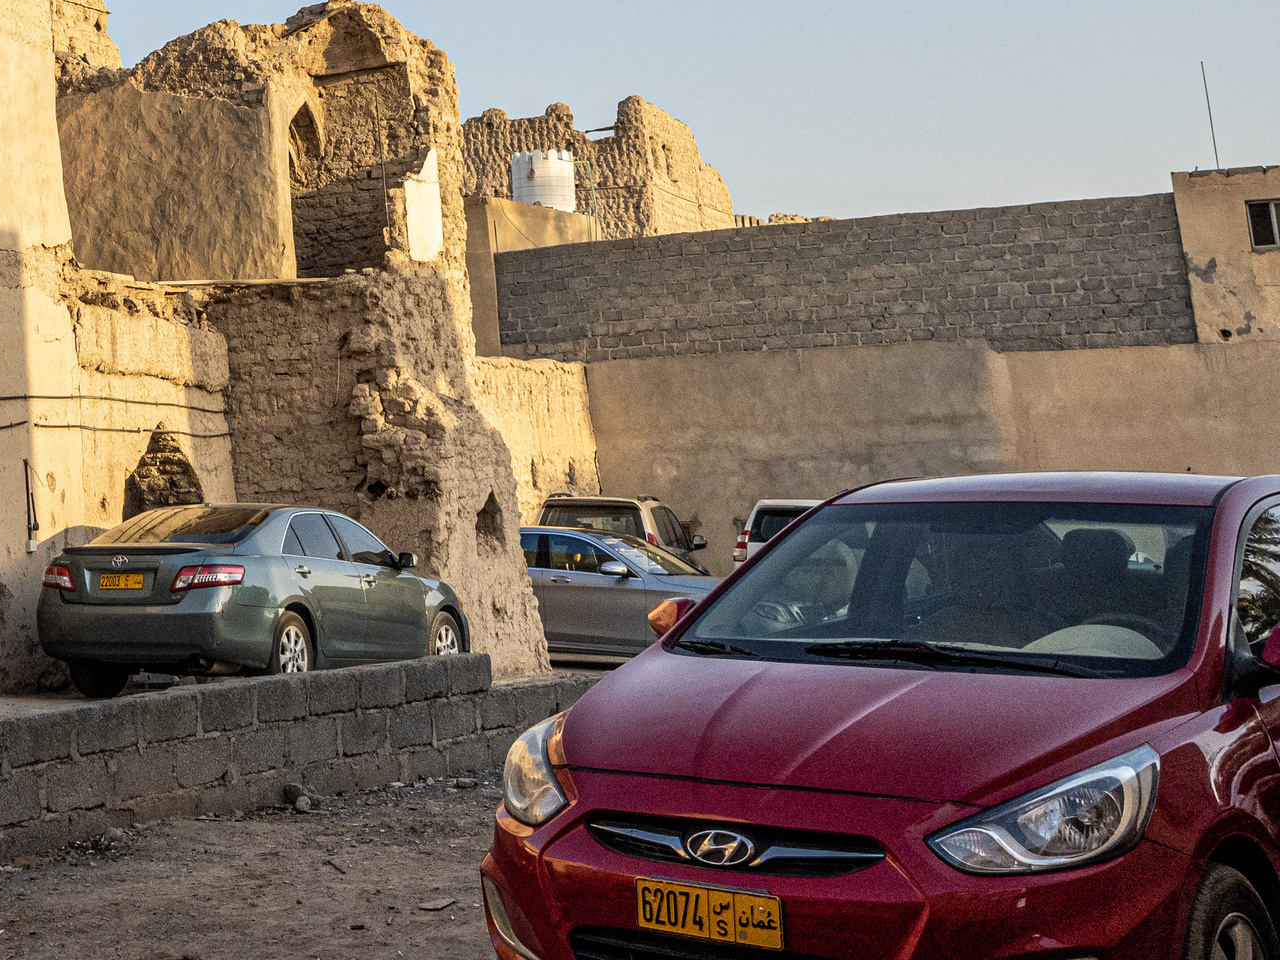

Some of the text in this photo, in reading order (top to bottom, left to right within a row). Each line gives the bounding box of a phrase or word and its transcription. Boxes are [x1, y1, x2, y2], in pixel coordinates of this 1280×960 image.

[100, 575, 120, 587] 22003
[641, 886, 704, 931] 62074
[713, 901, 730, 915] س
[716, 919, 728, 936] S
